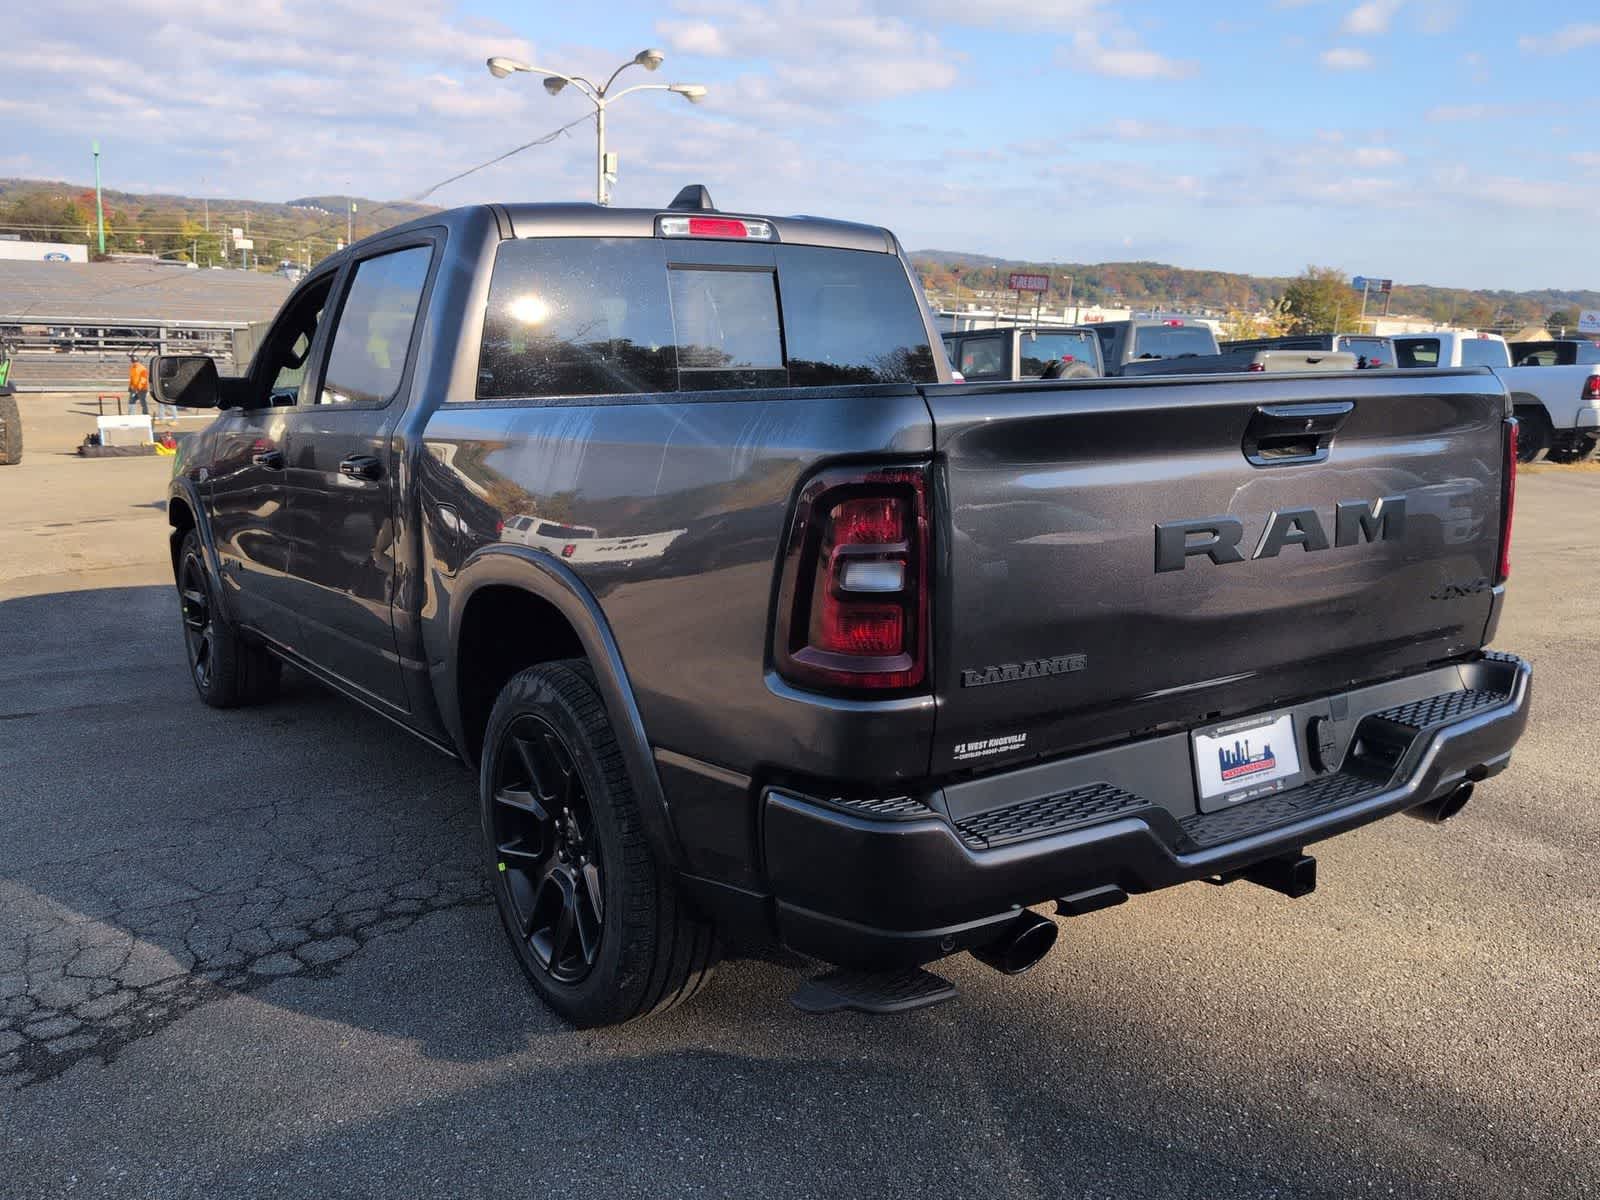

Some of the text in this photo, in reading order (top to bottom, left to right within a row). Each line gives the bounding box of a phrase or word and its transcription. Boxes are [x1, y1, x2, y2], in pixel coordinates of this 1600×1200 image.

[1154, 495, 1407, 573] RAM
[961, 653, 1089, 688] LARAMIE
[954, 733, 1027, 753] #1 WEST KNOXVILLE
